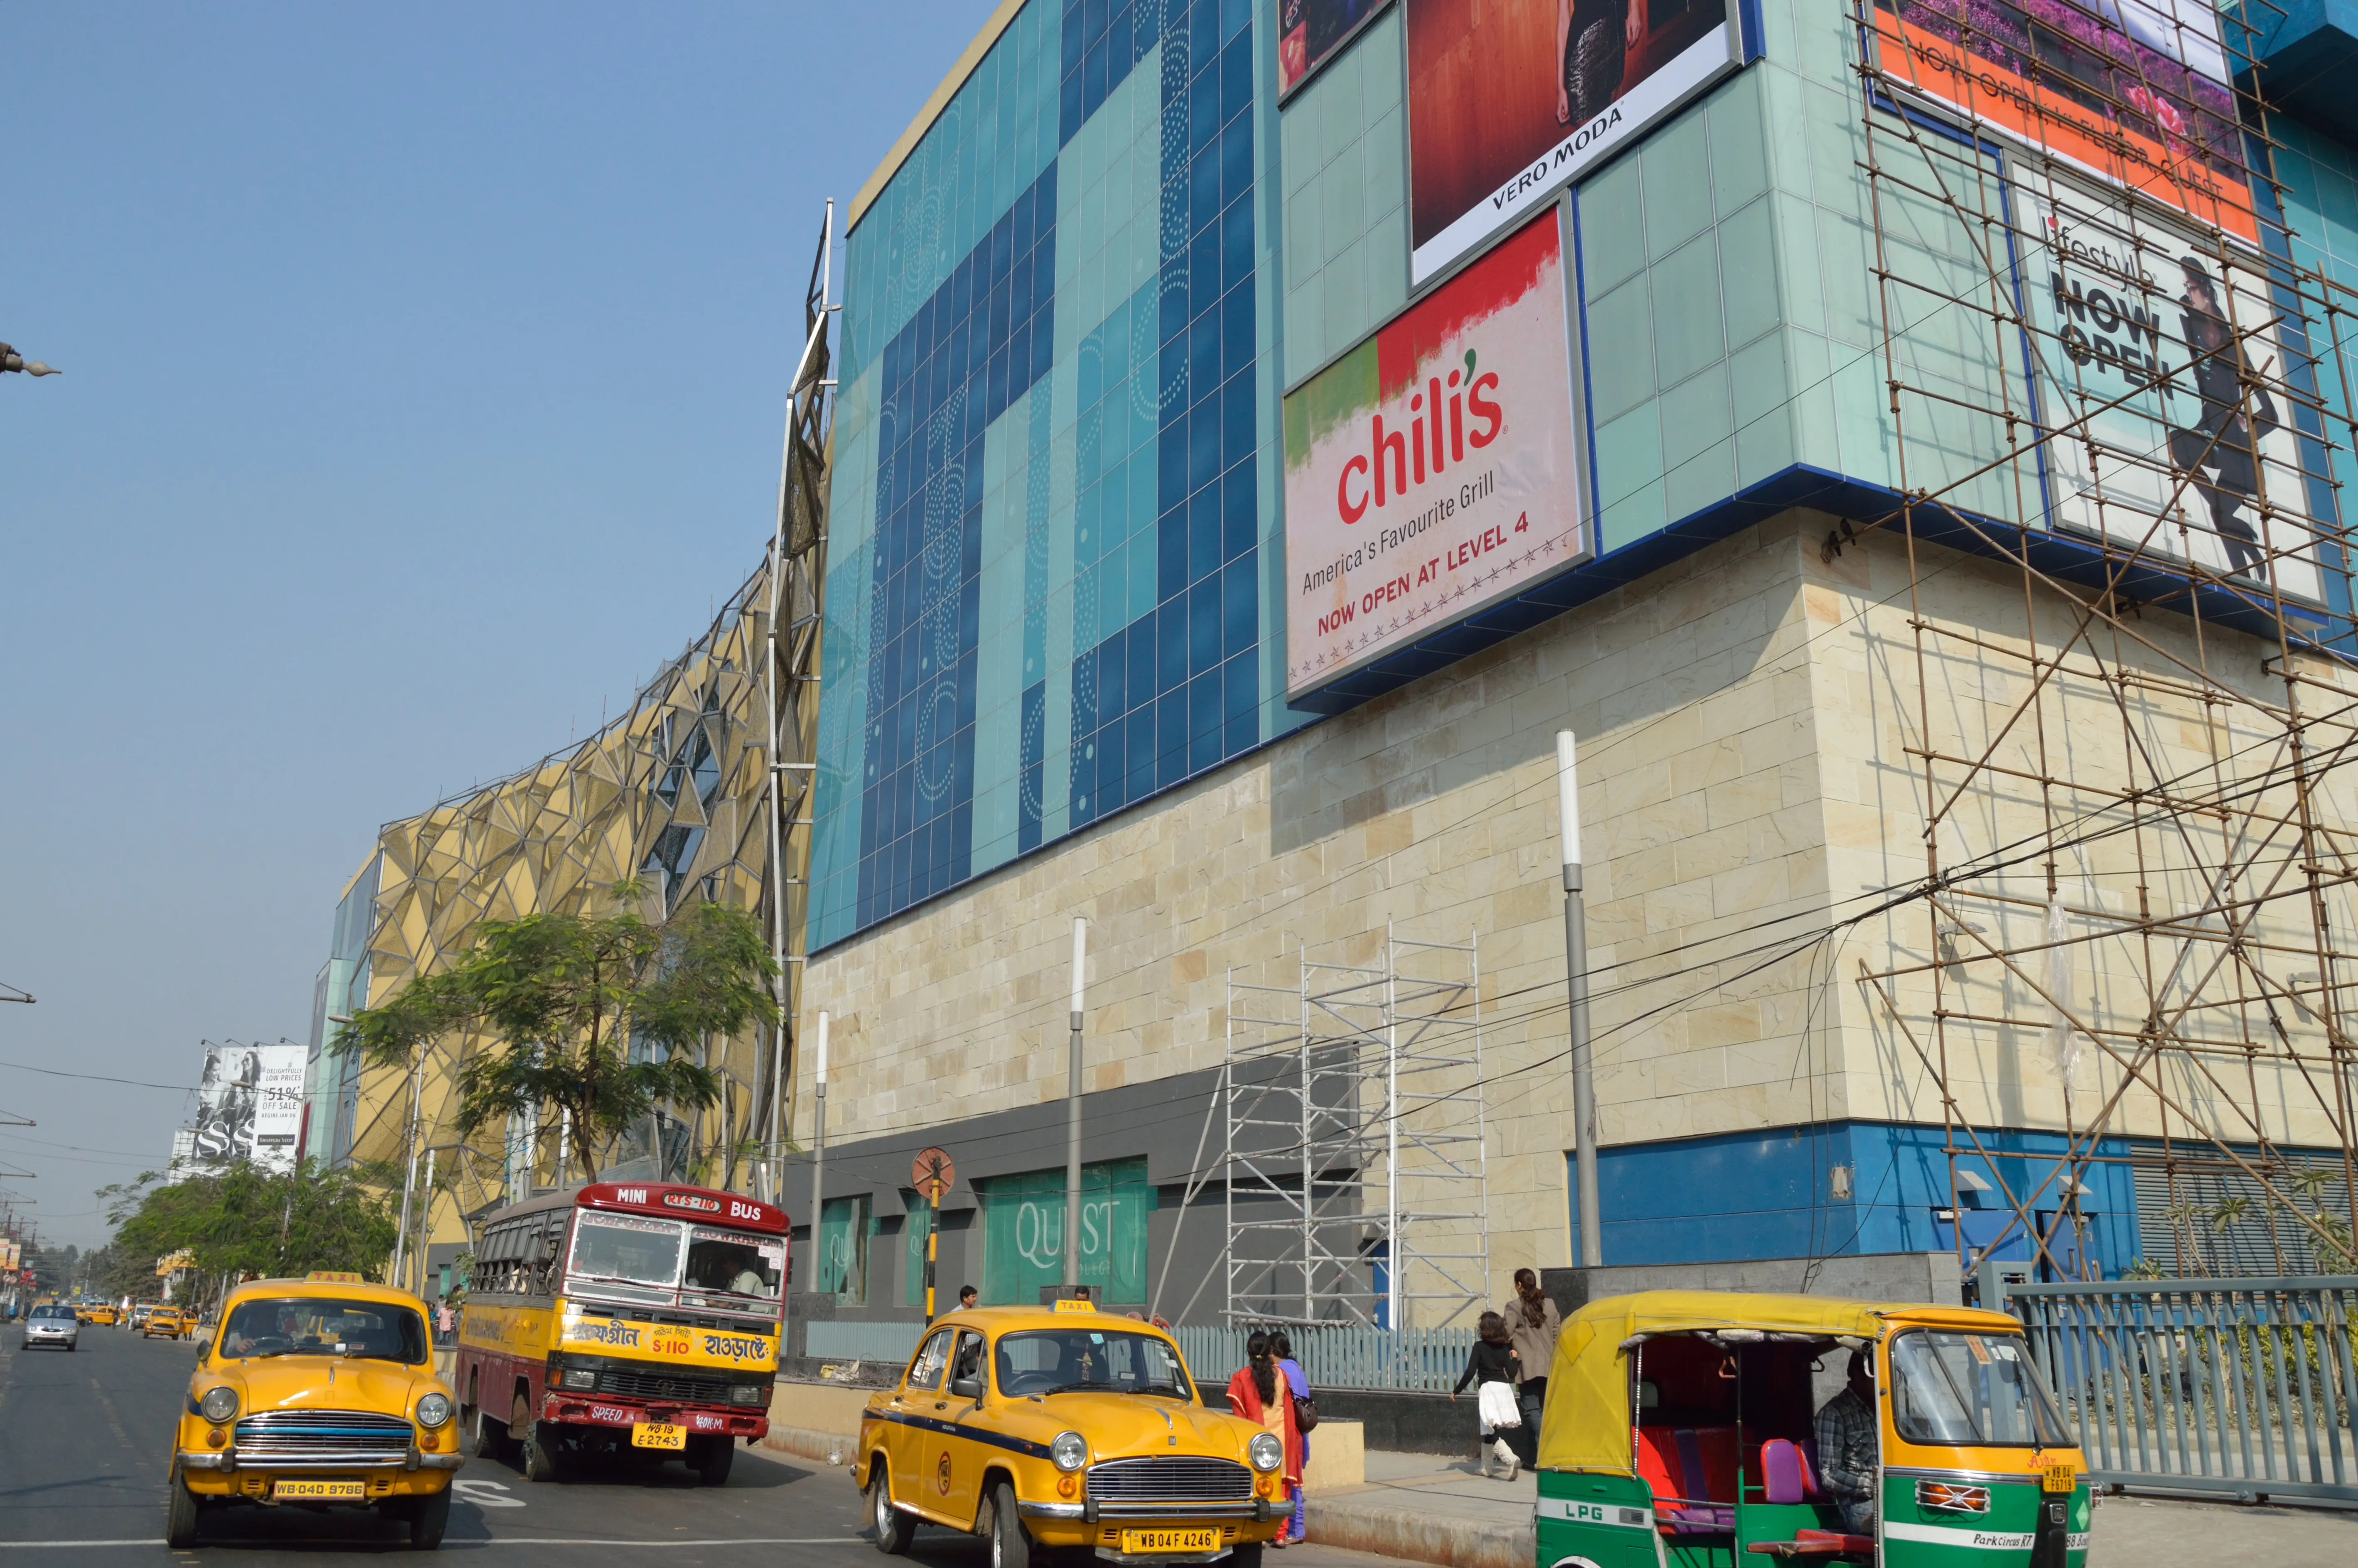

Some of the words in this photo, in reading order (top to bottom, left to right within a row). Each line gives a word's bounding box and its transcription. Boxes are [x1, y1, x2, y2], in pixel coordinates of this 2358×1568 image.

[1493, 162, 1547, 211] VERO
[1554, 107, 1622, 169] MODA
[2051, 271, 2160, 353] NOW
[2060, 323, 2174, 400] OPEN
[1338, 348, 1502, 524] chili's
[1303, 543, 1376, 596] America's
[1380, 497, 1454, 555] Favourite
[1460, 470, 1494, 509] Grill
[1318, 601, 1354, 637] NOW
[1362, 573, 1409, 614] OPEN
[1417, 558, 1440, 588] AT
[1447, 524, 1507, 571] LEVEL
[1514, 510, 1529, 533] 4
[617, 1189, 646, 1204] MINI
[730, 1201, 761, 1220] BUS
[315, 1272, 355, 1282] TAXI
[592, 1406, 623, 1421] SPEED
[1566, 1504, 1602, 1520] LPG
